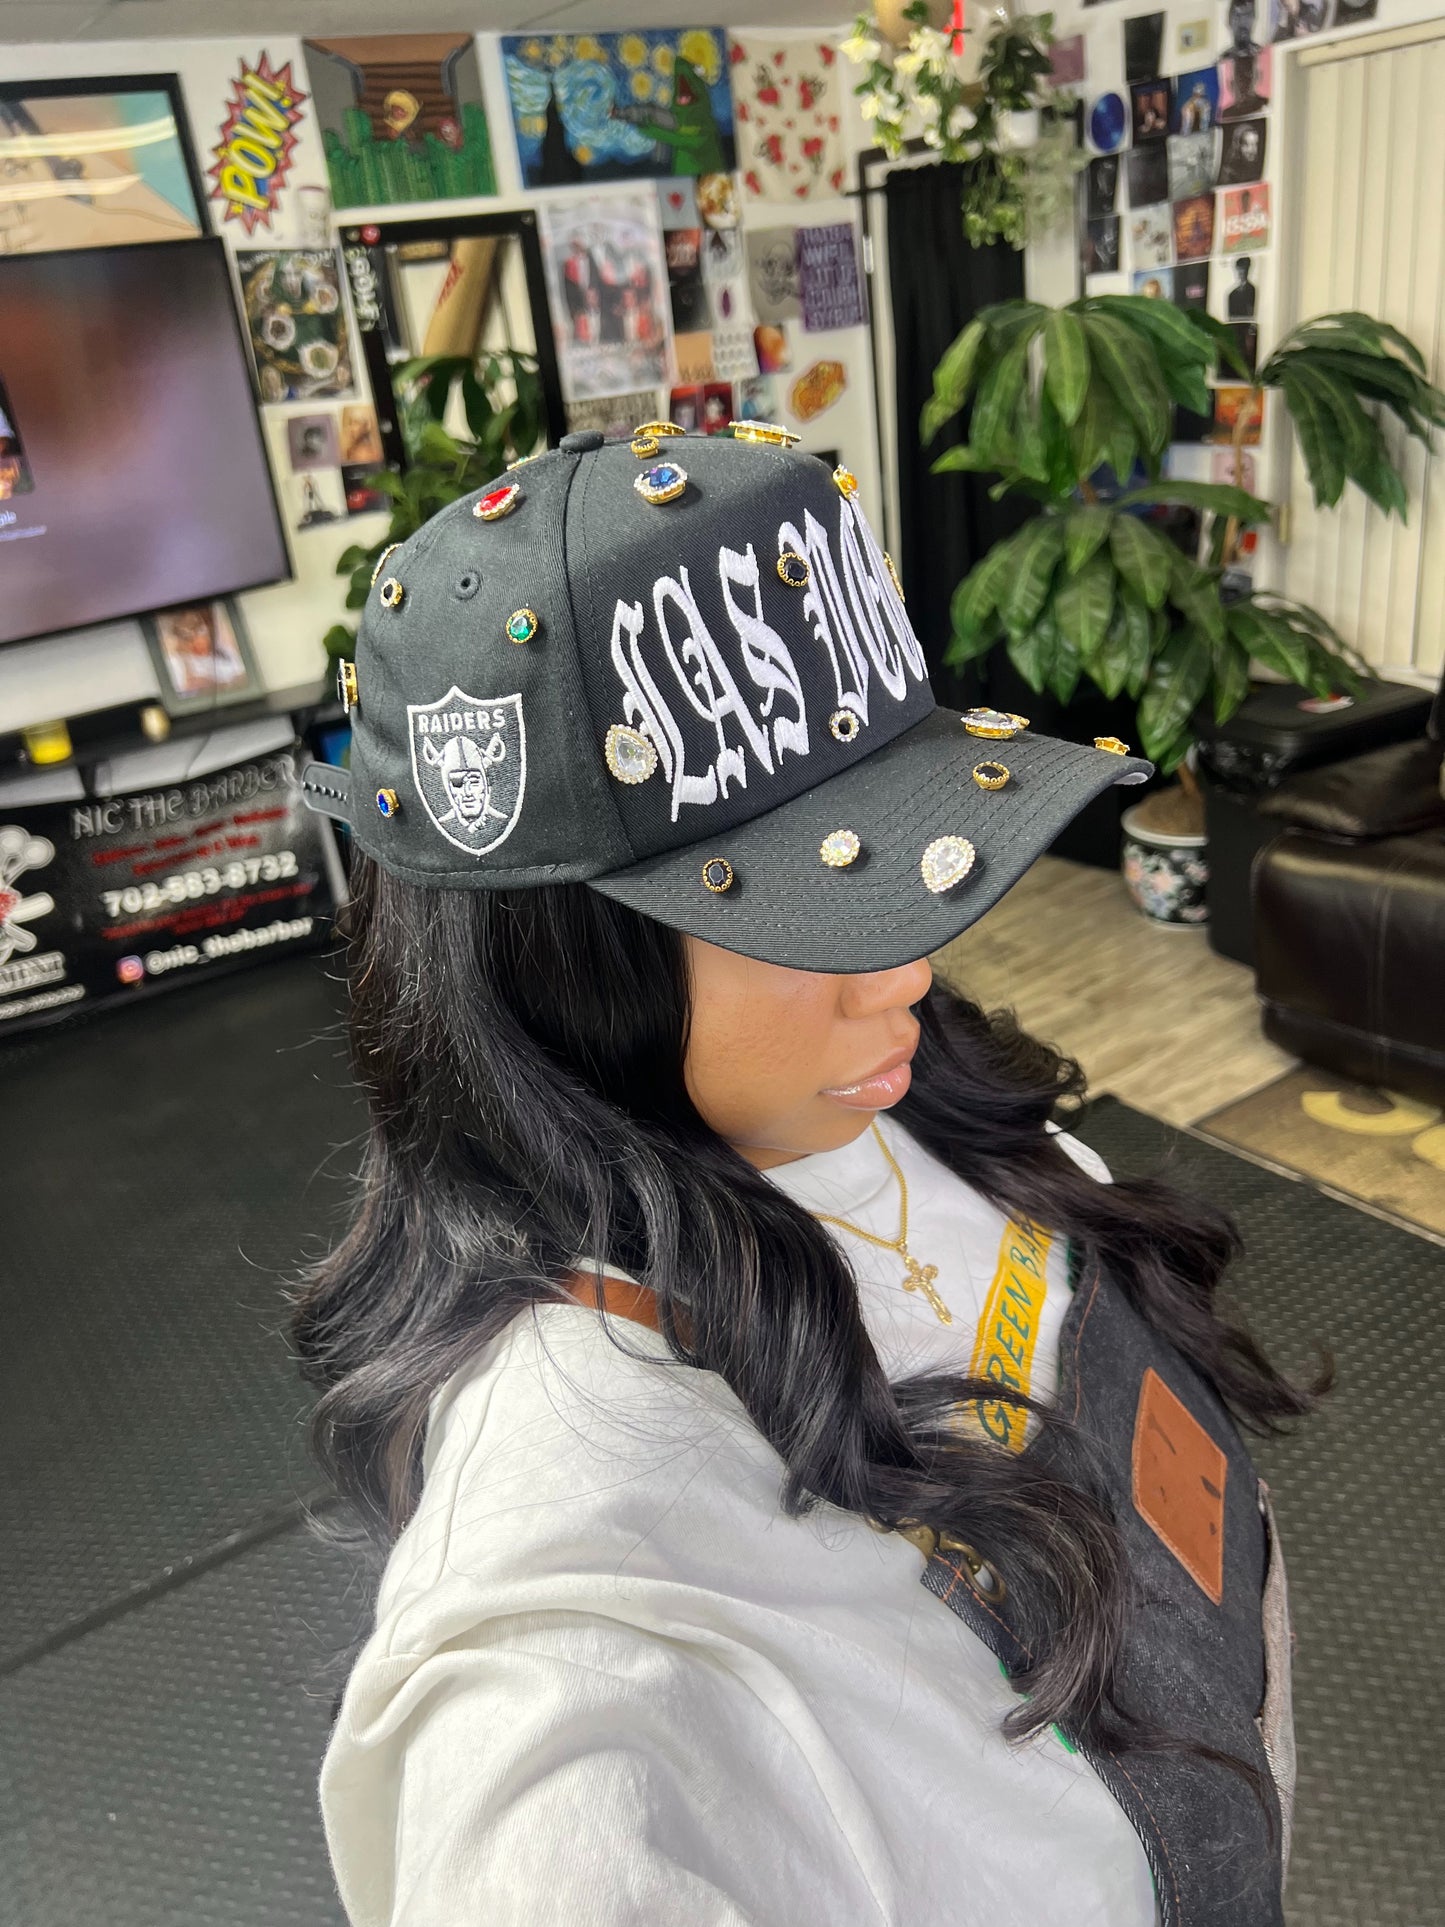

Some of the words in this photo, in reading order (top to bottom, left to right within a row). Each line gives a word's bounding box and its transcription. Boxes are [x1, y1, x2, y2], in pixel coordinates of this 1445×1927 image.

[221, 72, 292, 211] POW!
[418, 708, 506, 734] RAIDERS
[609, 542, 809, 823] LAS
[71, 799, 125, 841] NIC
[127, 789, 185, 830] THE
[976, 1270, 1033, 1446] GREEN
